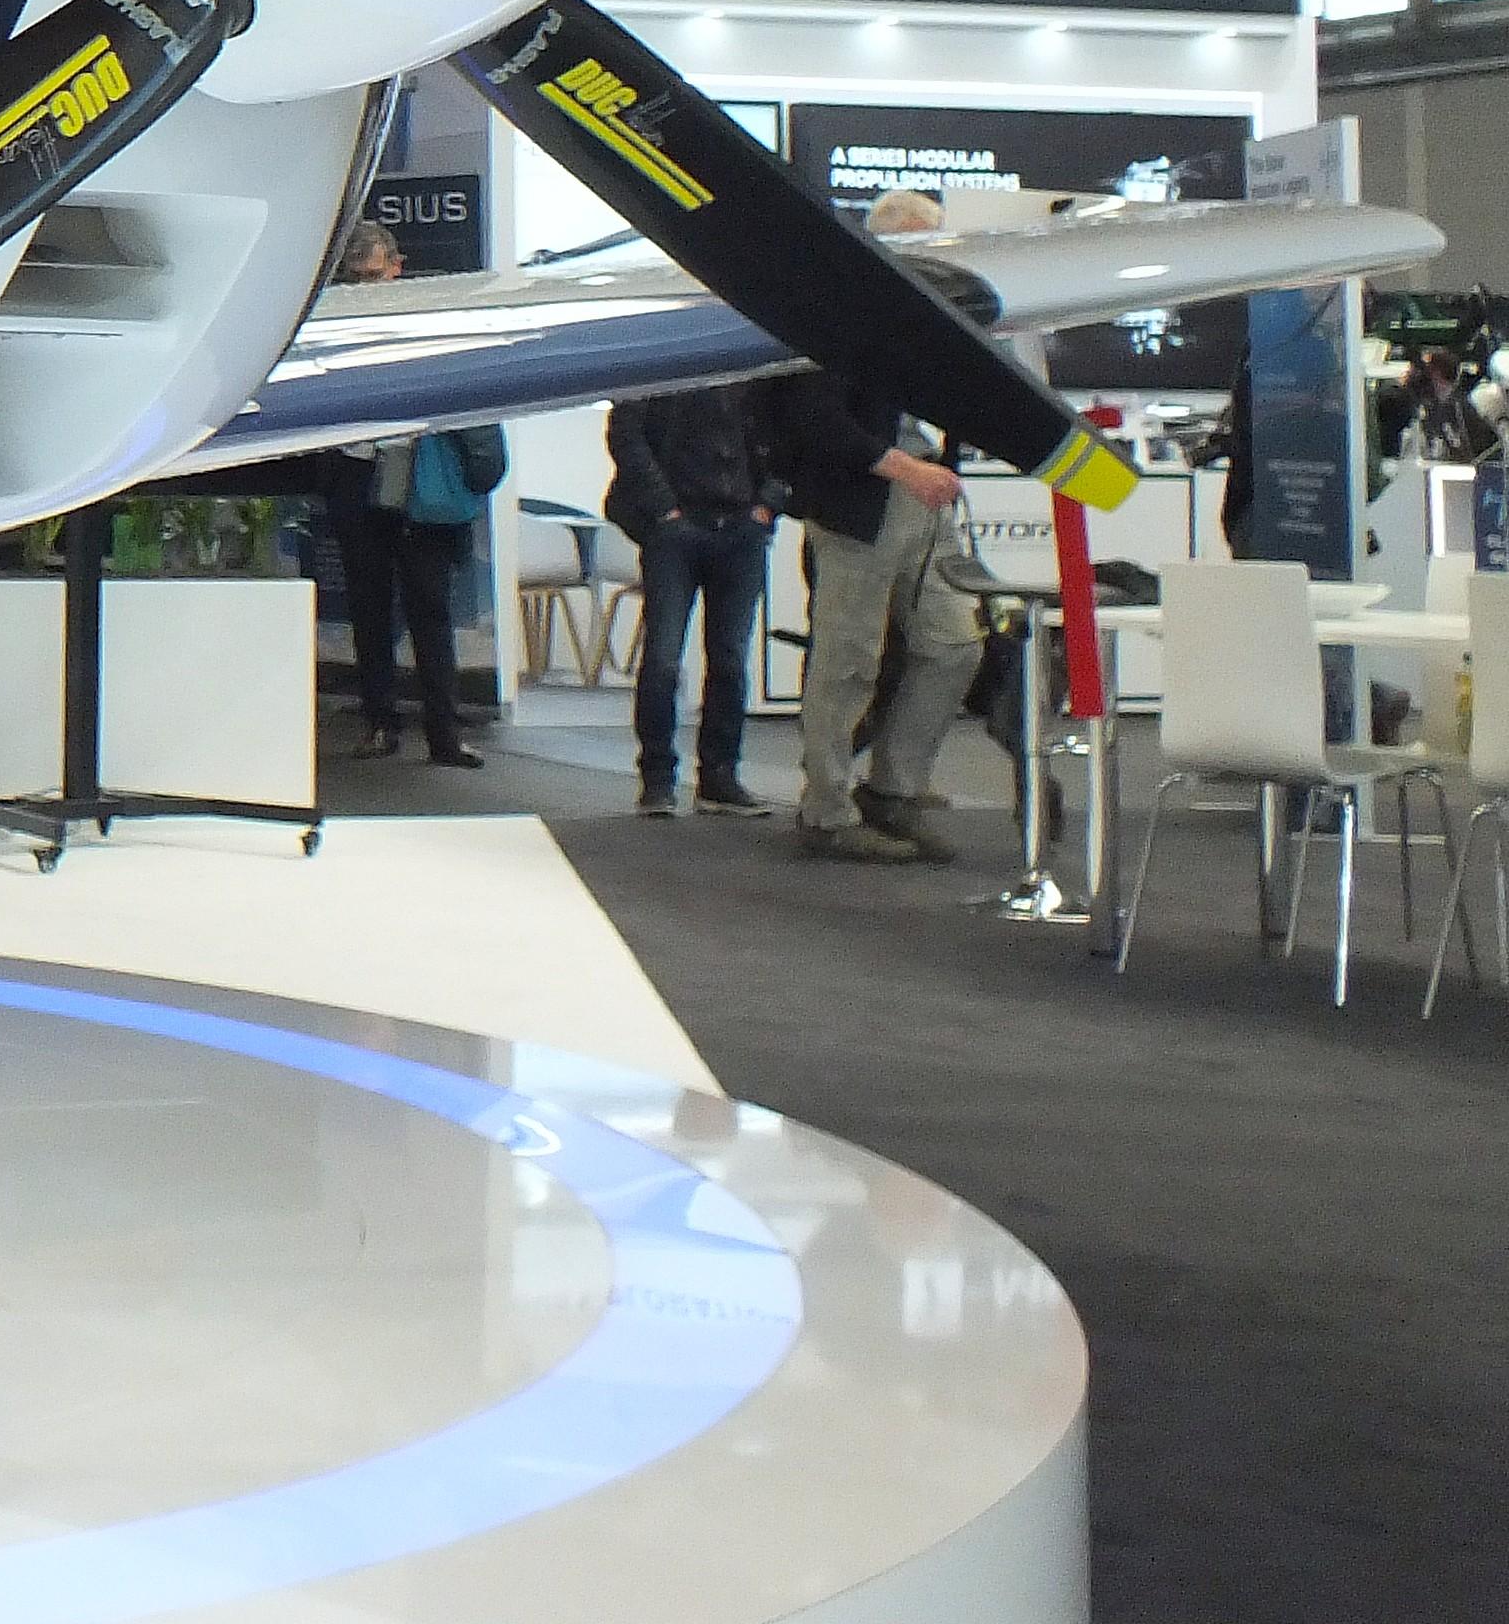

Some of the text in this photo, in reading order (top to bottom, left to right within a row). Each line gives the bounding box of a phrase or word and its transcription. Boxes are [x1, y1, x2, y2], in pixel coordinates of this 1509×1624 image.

[49, 51, 131, 137] DUC
[556, 58, 638, 117] DUC
[378, 191, 468, 226] SIUS
